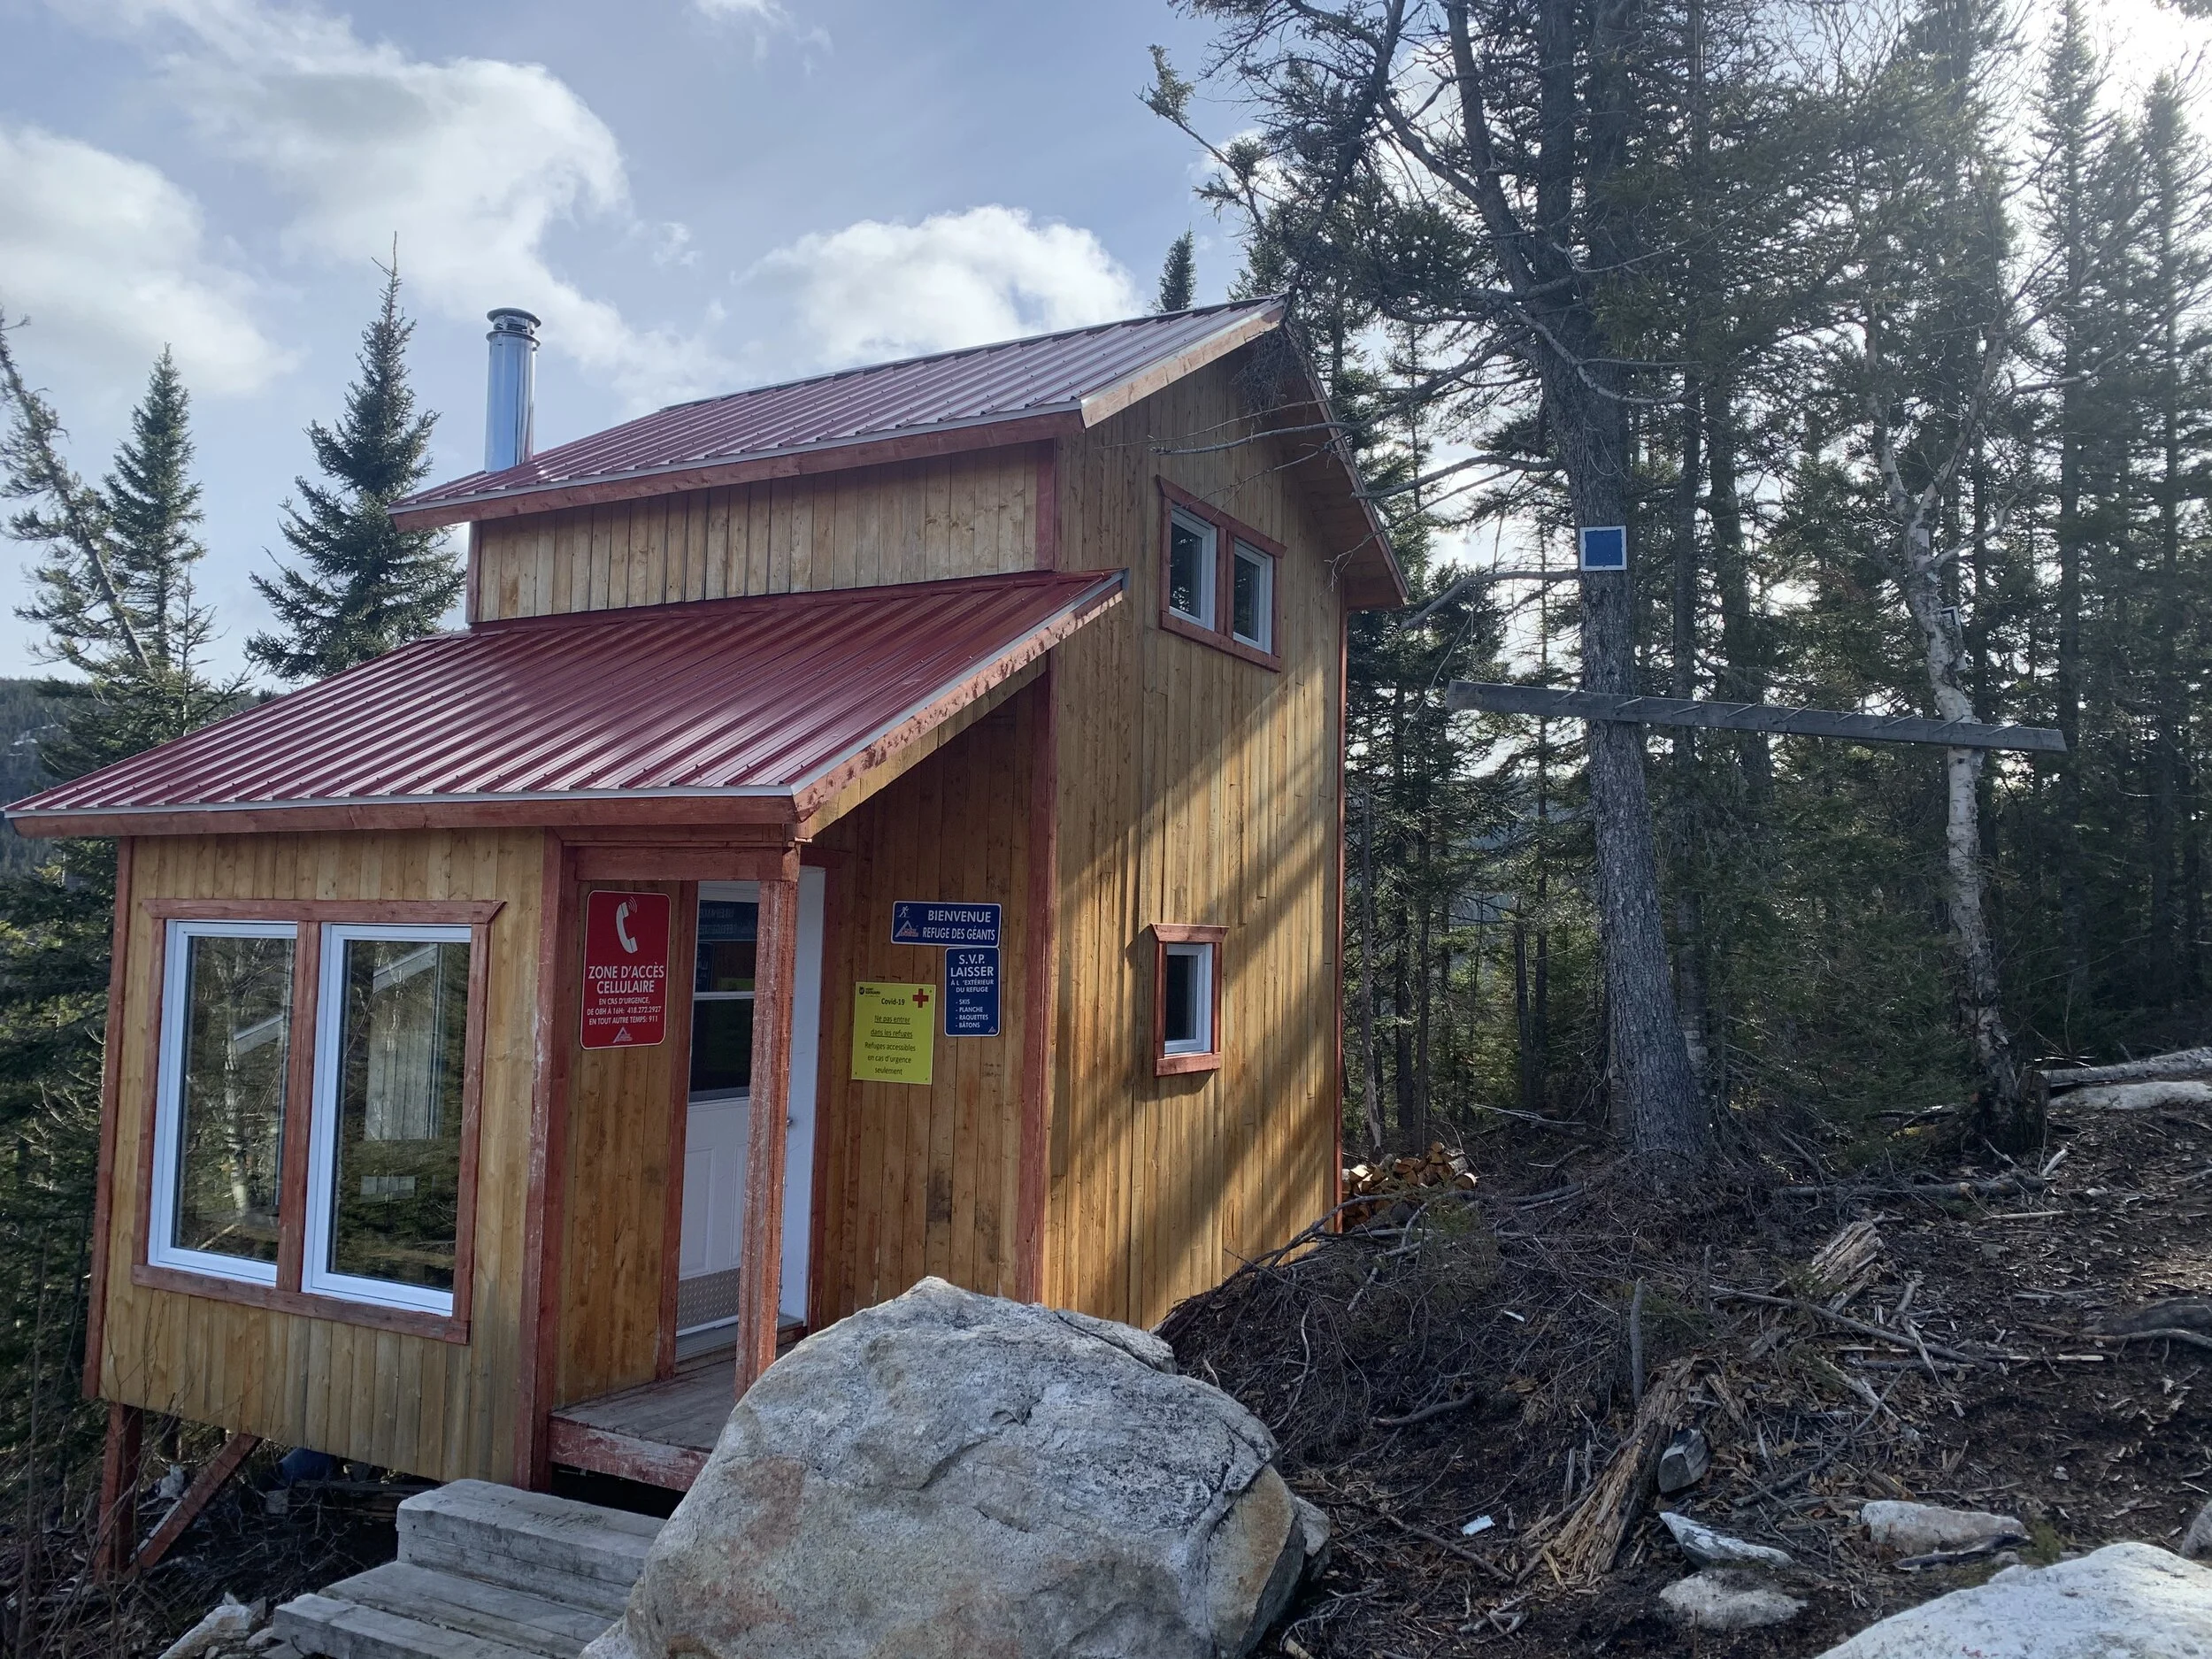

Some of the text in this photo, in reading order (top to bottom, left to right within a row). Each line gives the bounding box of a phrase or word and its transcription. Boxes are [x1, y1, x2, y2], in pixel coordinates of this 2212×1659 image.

[927, 910, 992, 923] BIENVENUE
[922, 926, 949, 939] REFUGE
[951, 927, 965, 939] DES
[966, 926, 995, 941] GÉANTS
[958, 954, 985, 964] S.V.P.
[588, 962, 664, 979] ZONE D'ACCÈS
[950, 966, 995, 977] LAISSER
[596, 980, 655, 994] CELLULAIRE
[892, 1030, 913, 1039] refuges
[864, 1041, 886, 1050] Refuges
[885, 1055, 911, 1064] d'urgence
